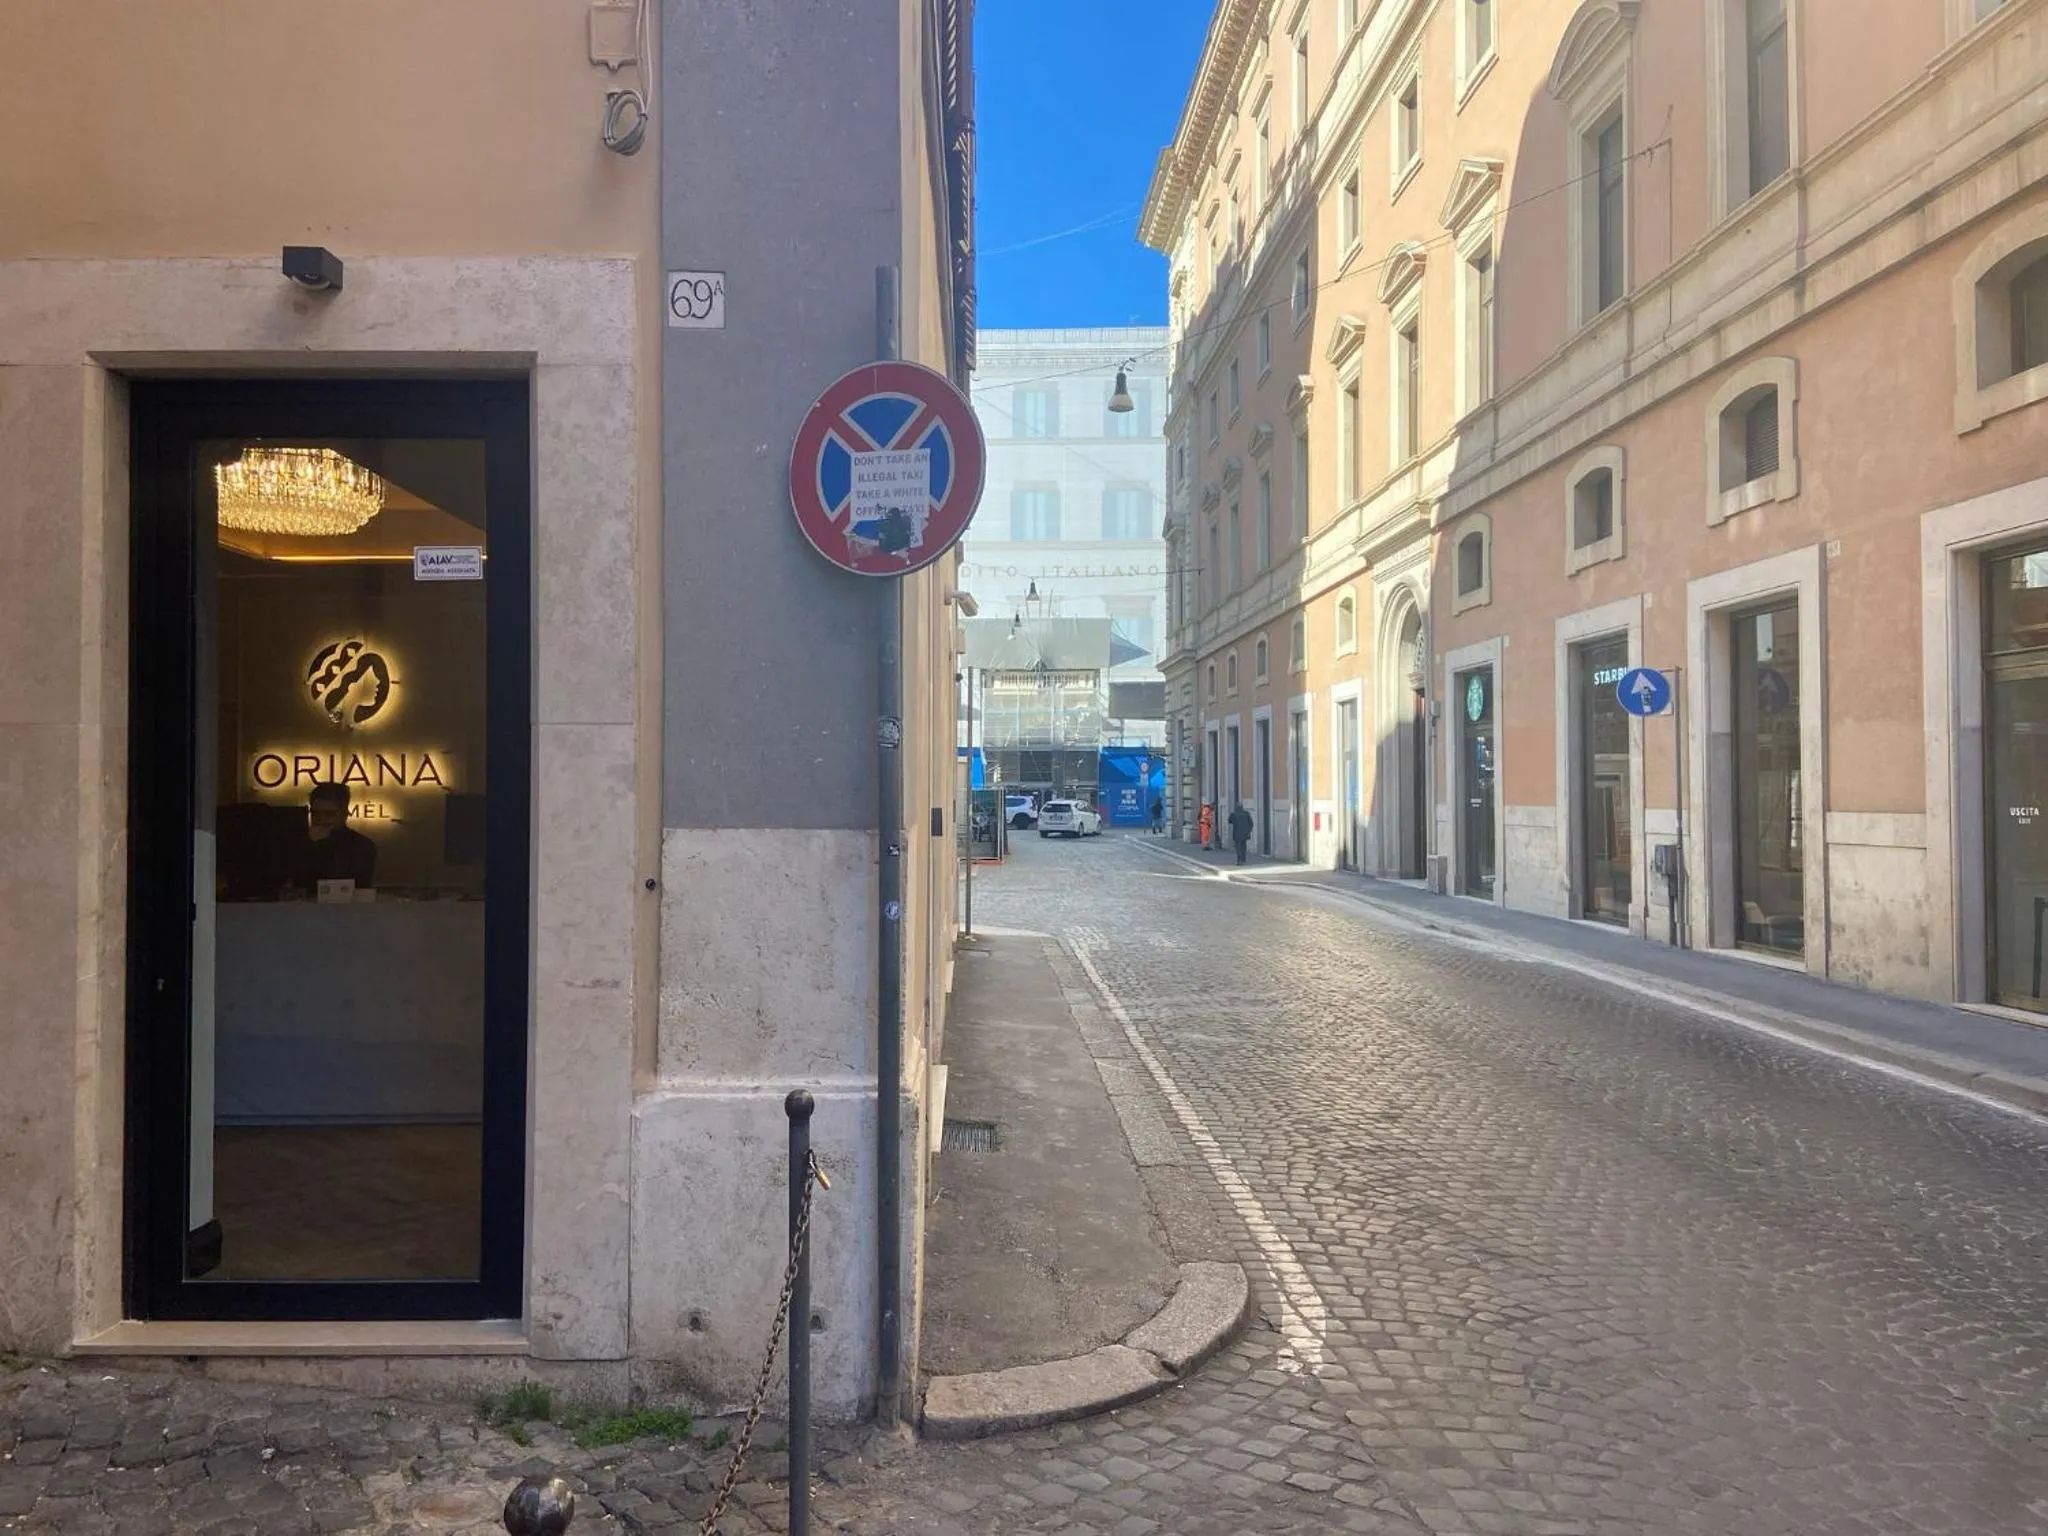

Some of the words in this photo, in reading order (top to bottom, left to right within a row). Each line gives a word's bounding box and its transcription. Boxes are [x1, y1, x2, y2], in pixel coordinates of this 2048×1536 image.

[885, 454, 911, 464] TAKE
[914, 453, 929, 463] AN
[858, 471, 898, 482] ILLEGAL
[902, 469, 923, 480] TAXI
[856, 489, 881, 500] TAKE
[893, 487, 923, 497] WHITE
[1041, 565, 1159, 578] ITALIANO
[253, 753, 443, 788] ORIANA
[2009, 807, 2040, 816] USCITA
